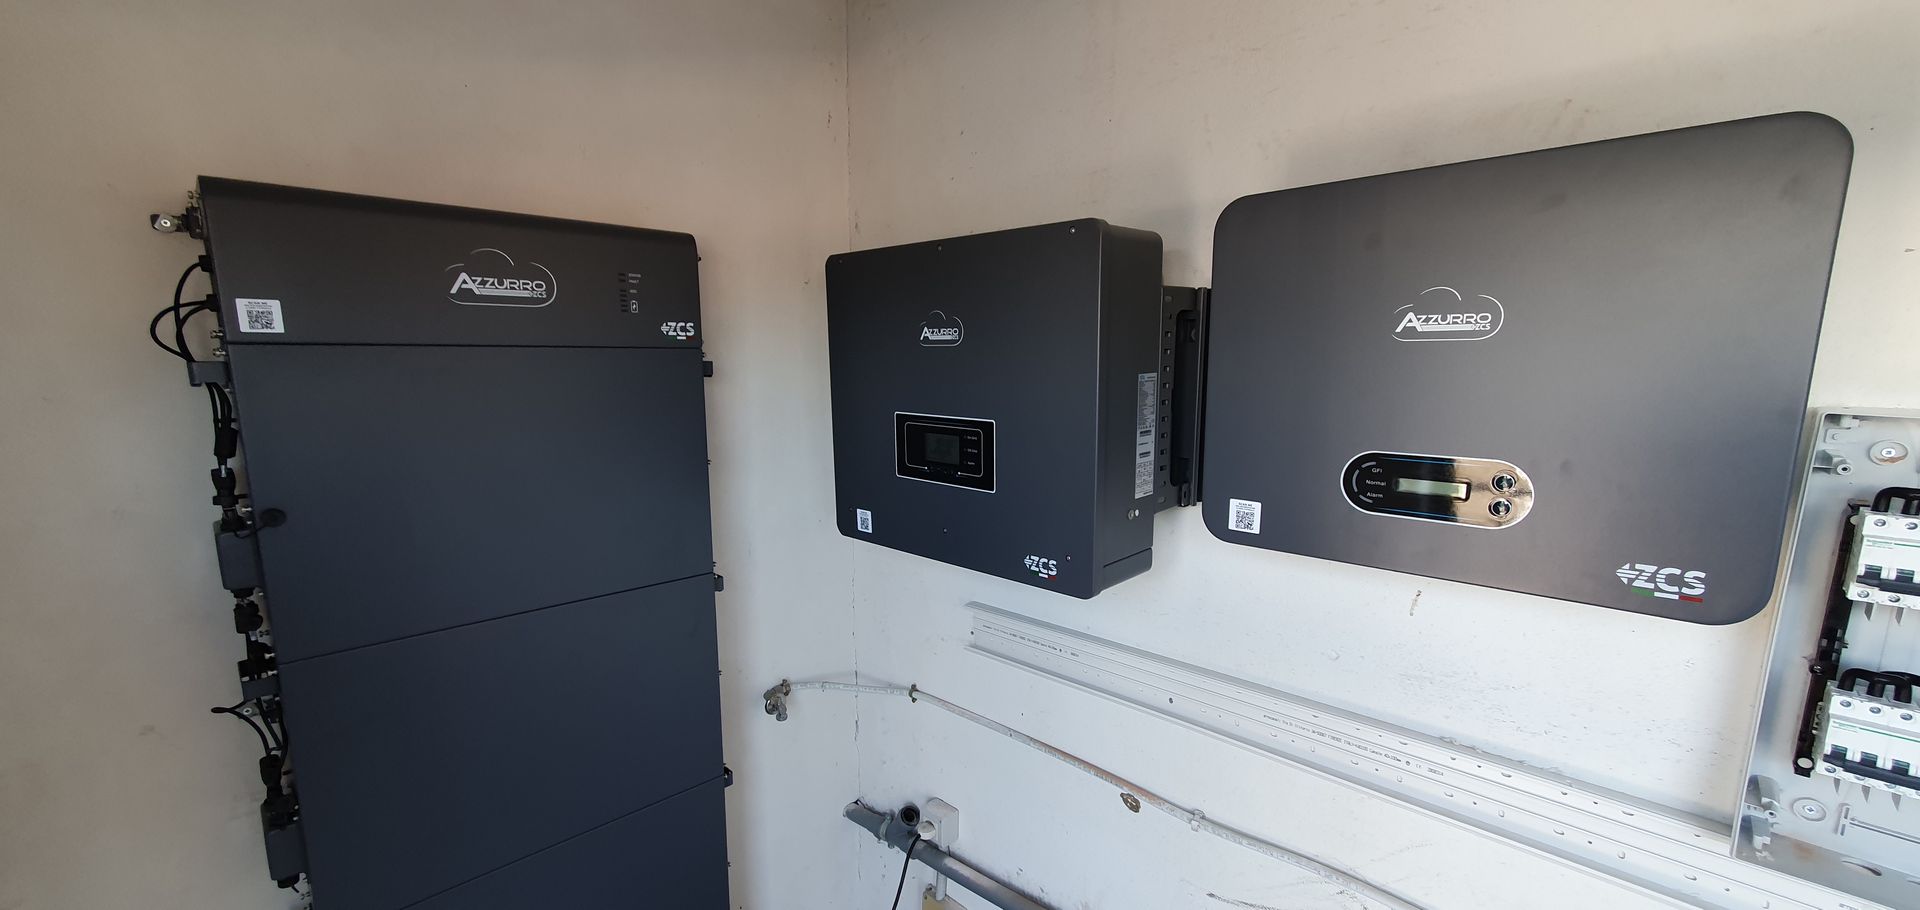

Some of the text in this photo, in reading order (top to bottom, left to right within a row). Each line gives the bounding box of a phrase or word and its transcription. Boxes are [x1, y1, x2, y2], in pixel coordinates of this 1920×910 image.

[450, 272, 546, 294] AZZURRO
[667, 322, 695, 336] ZCS
[1395, 312, 1492, 332] AZZURRO
[1475, 323, 1491, 331] ZCS
[920, 326, 959, 340] AZZURRO
[1365, 479, 1387, 487] Normal
[1030, 555, 1057, 576] ZCS
[1631, 563, 1707, 596] ZCS
